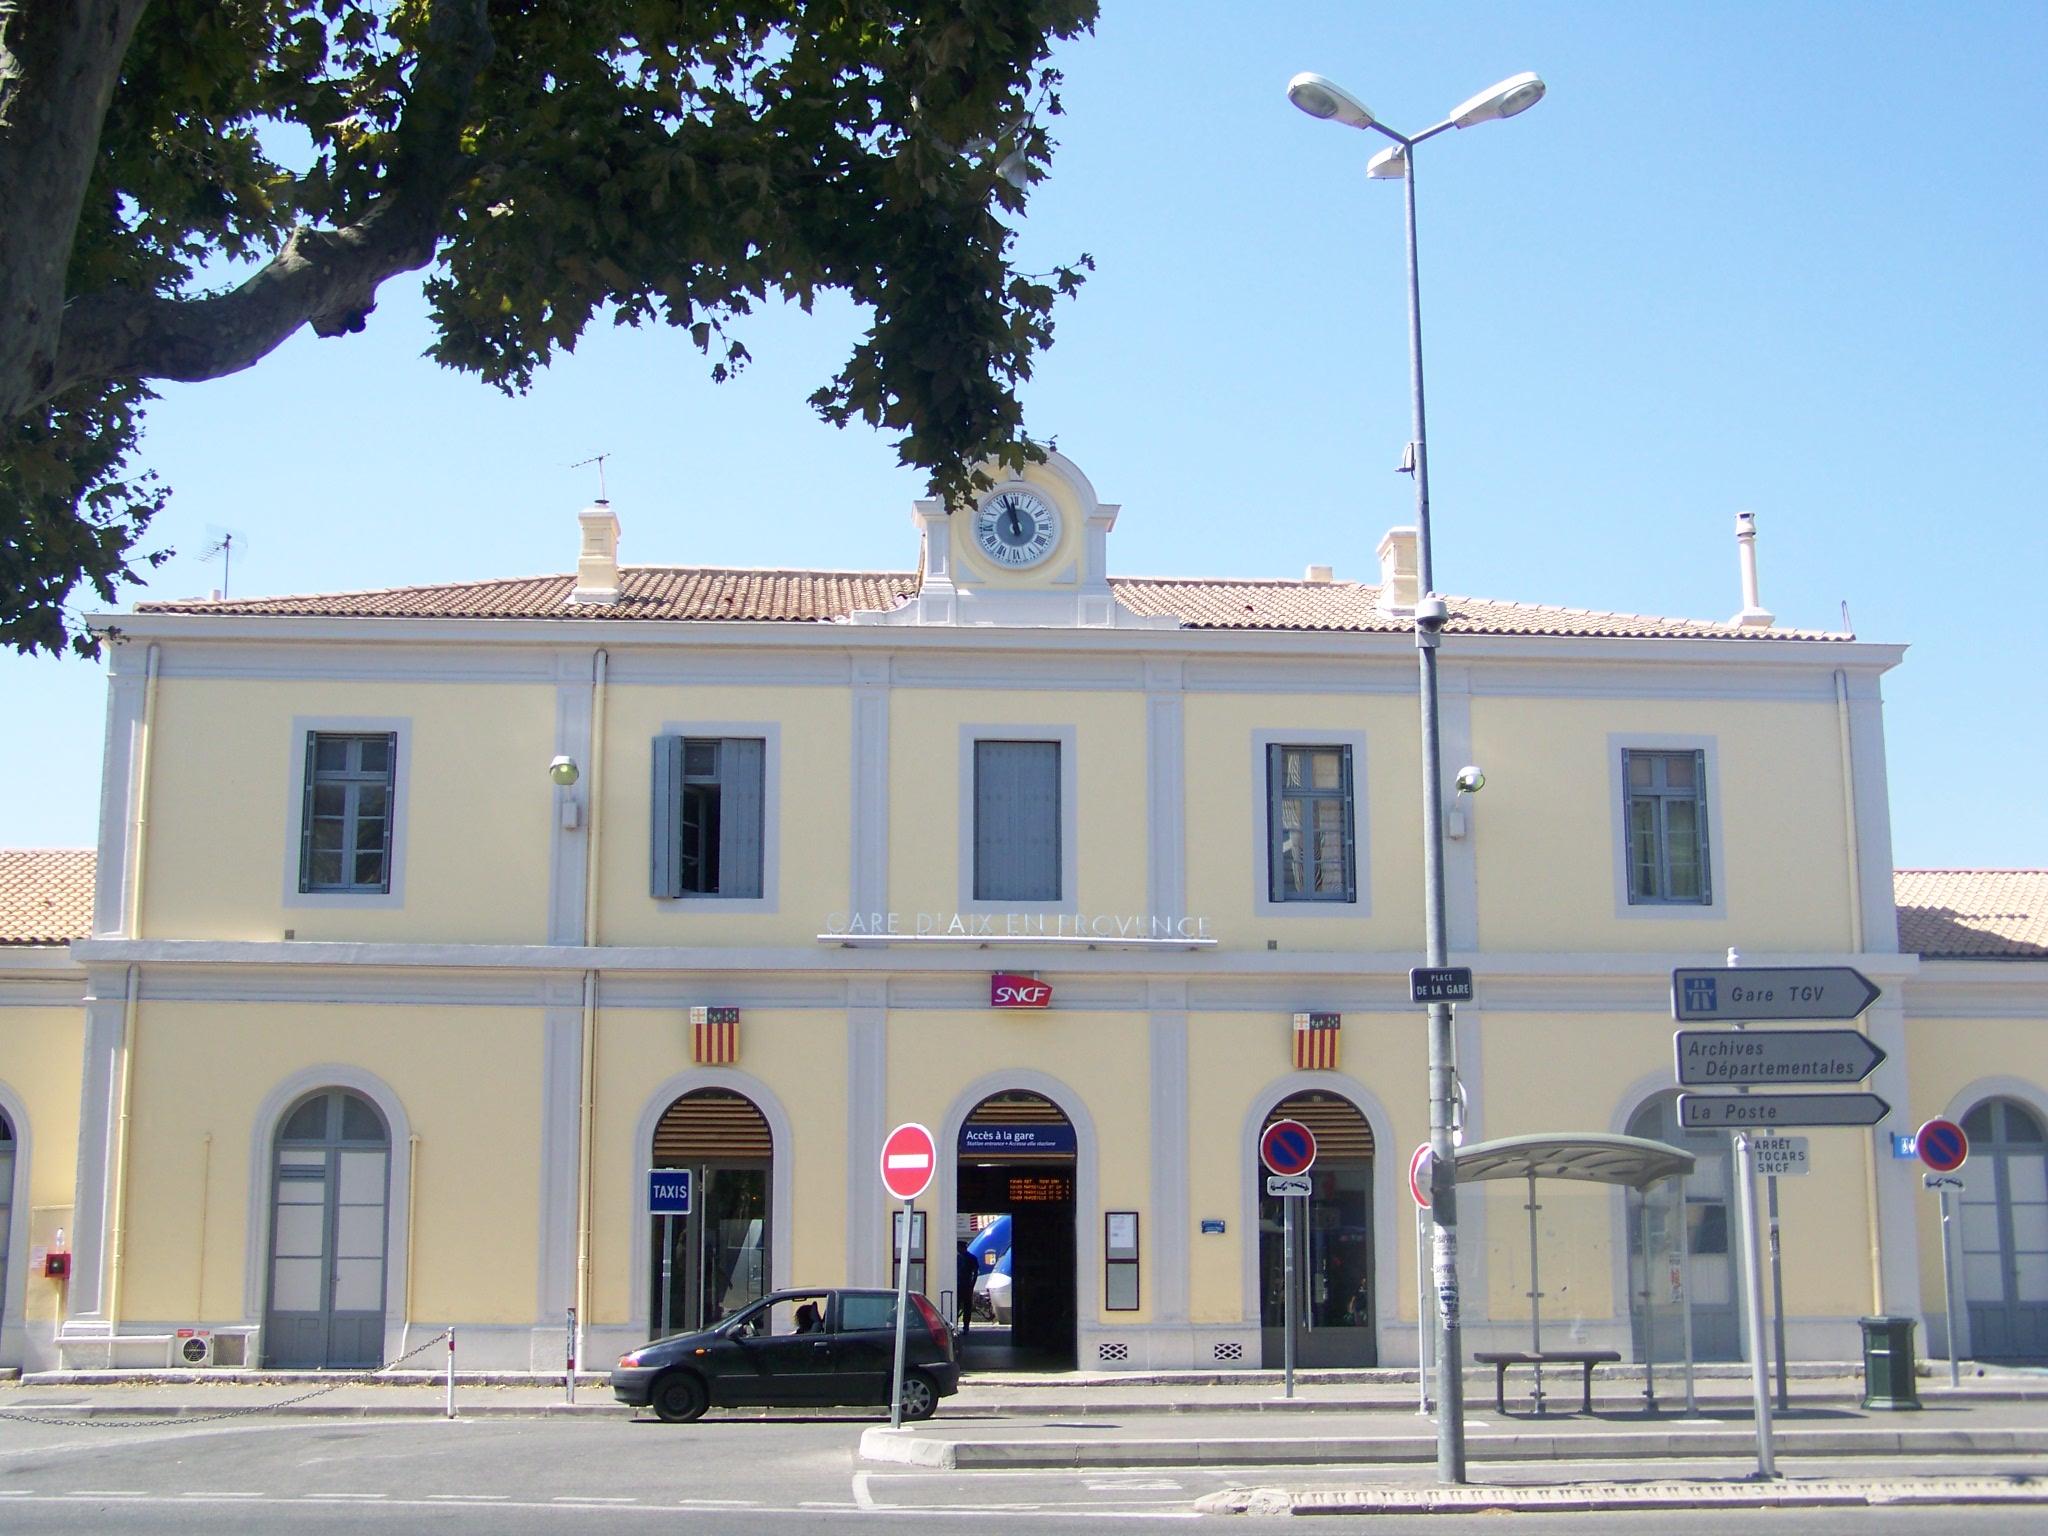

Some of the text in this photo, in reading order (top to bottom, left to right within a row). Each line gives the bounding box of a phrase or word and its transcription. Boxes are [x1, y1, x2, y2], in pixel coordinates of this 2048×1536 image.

[826, 912, 900, 933] GARE
[1007, 913, 1044, 934] EN
[1058, 914, 1212, 937] PROVENCE
[994, 987, 1048, 1002] SNCF
[1416, 984, 1469, 995] DE LA GARE
[1731, 986, 1824, 1001] Gare TGV
[1689, 1041, 1764, 1056] Archives
[1706, 1059, 1854, 1079] Départementales
[1692, 1104, 1777, 1120] La Poste
[966, 1131, 1035, 1142] Accès à la gare
[1754, 1138, 1791, 1149] ARRÊT
[1758, 1163, 1789, 1173] SNCF
[653, 1185, 687, 1199] TAXIS
